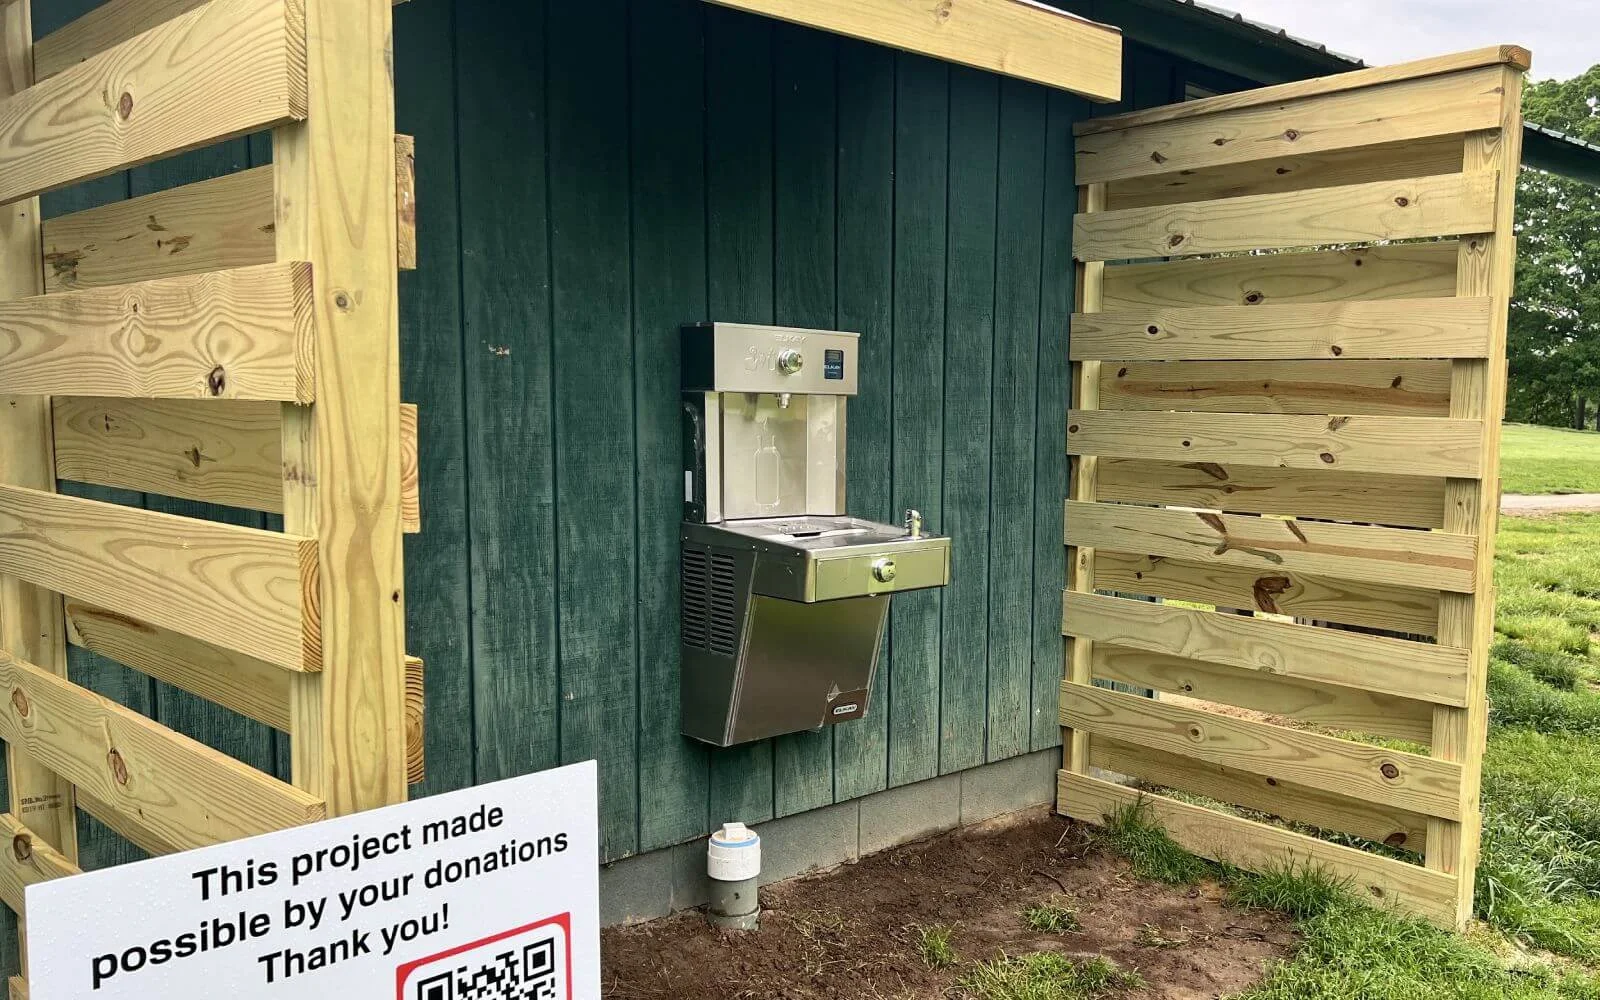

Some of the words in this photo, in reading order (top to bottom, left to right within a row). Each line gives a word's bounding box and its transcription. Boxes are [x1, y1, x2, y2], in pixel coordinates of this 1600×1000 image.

[191, 858, 278, 901] This
[292, 824, 412, 886] project
[422, 804, 504, 845] made
[92, 911, 271, 990] possible
[284, 897, 327, 931] by
[338, 873, 414, 922] your
[424, 832, 568, 889] donations
[257, 928, 371, 984] Thank
[380, 902, 449, 956] you!
